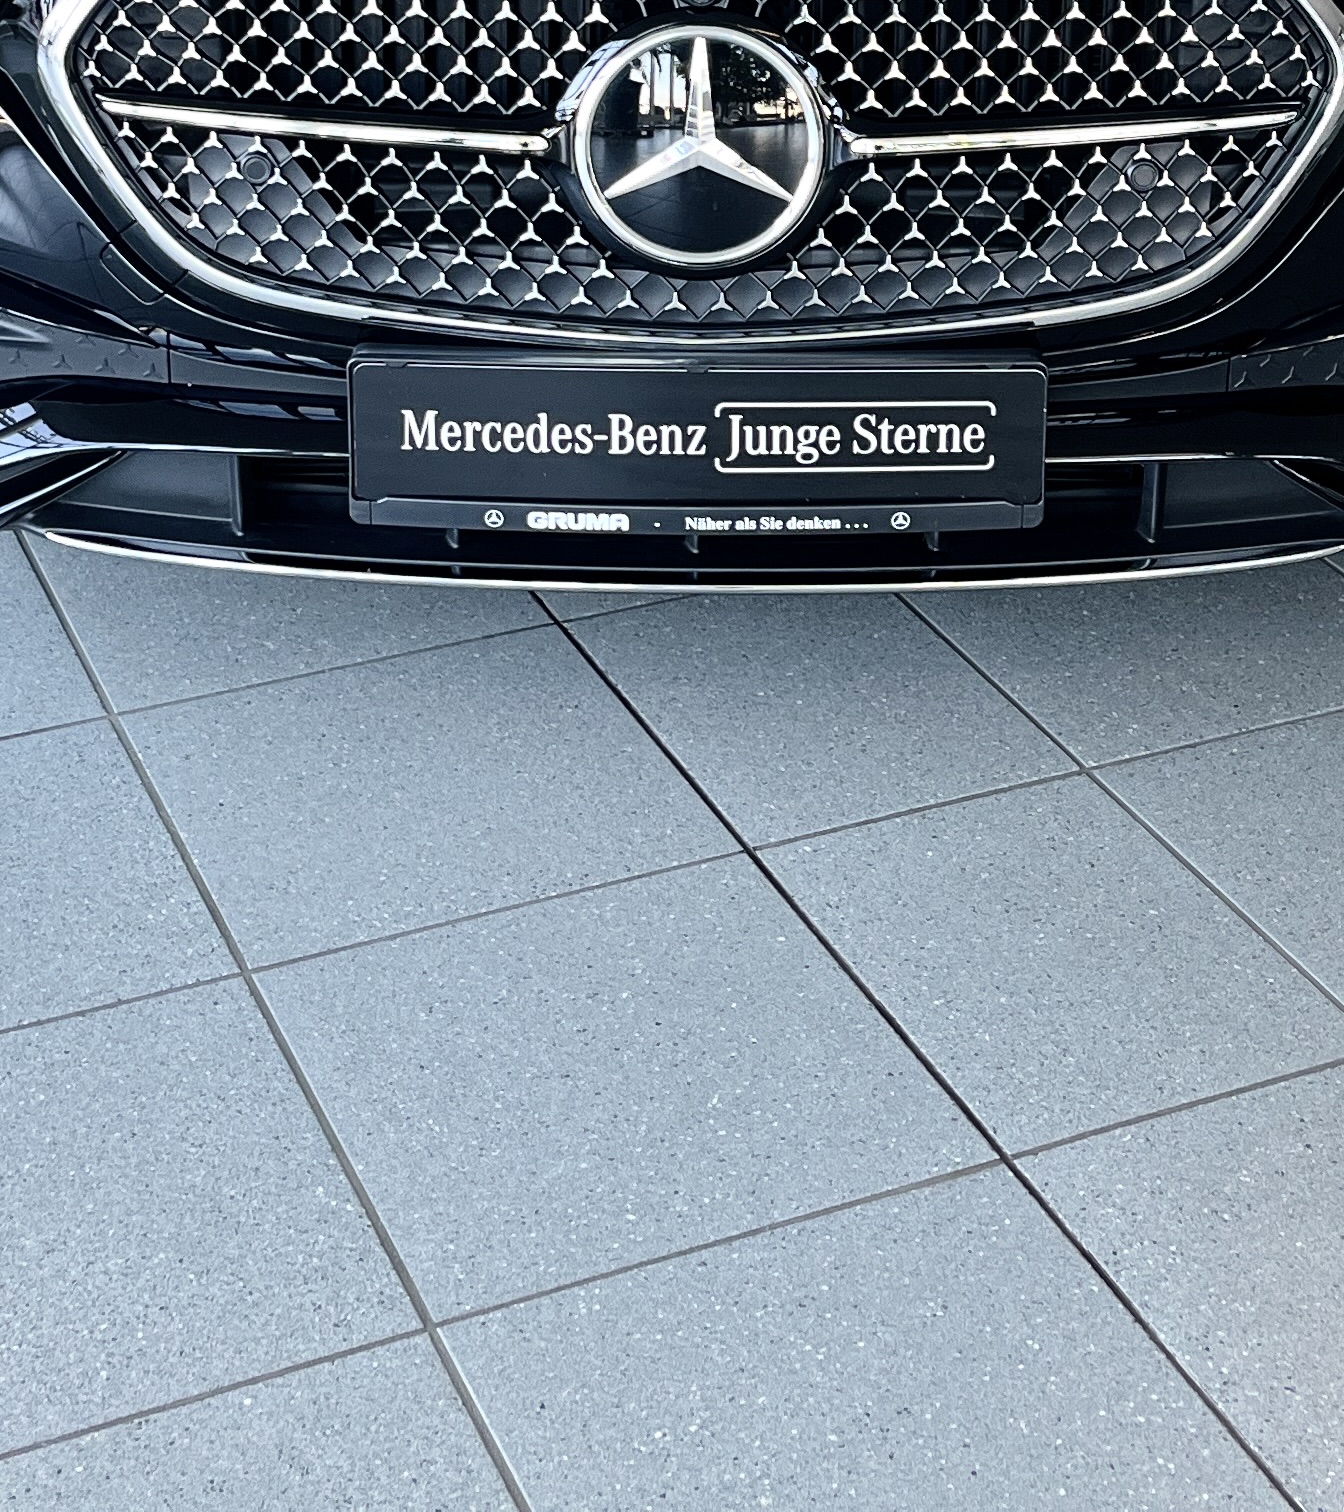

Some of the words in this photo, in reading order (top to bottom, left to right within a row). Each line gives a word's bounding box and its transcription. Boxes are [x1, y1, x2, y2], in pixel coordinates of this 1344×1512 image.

[400, 409, 708, 456] Mercedes-Benz
[724, 414, 842, 465] Junge
[852, 413, 987, 456] Sterne
[526, 510, 631, 532] GRUMA
[684, 515, 732, 532] Näher
[735, 515, 757, 532] als
[759, 515, 784, 532] Sie
[786, 515, 842, 531] denken
